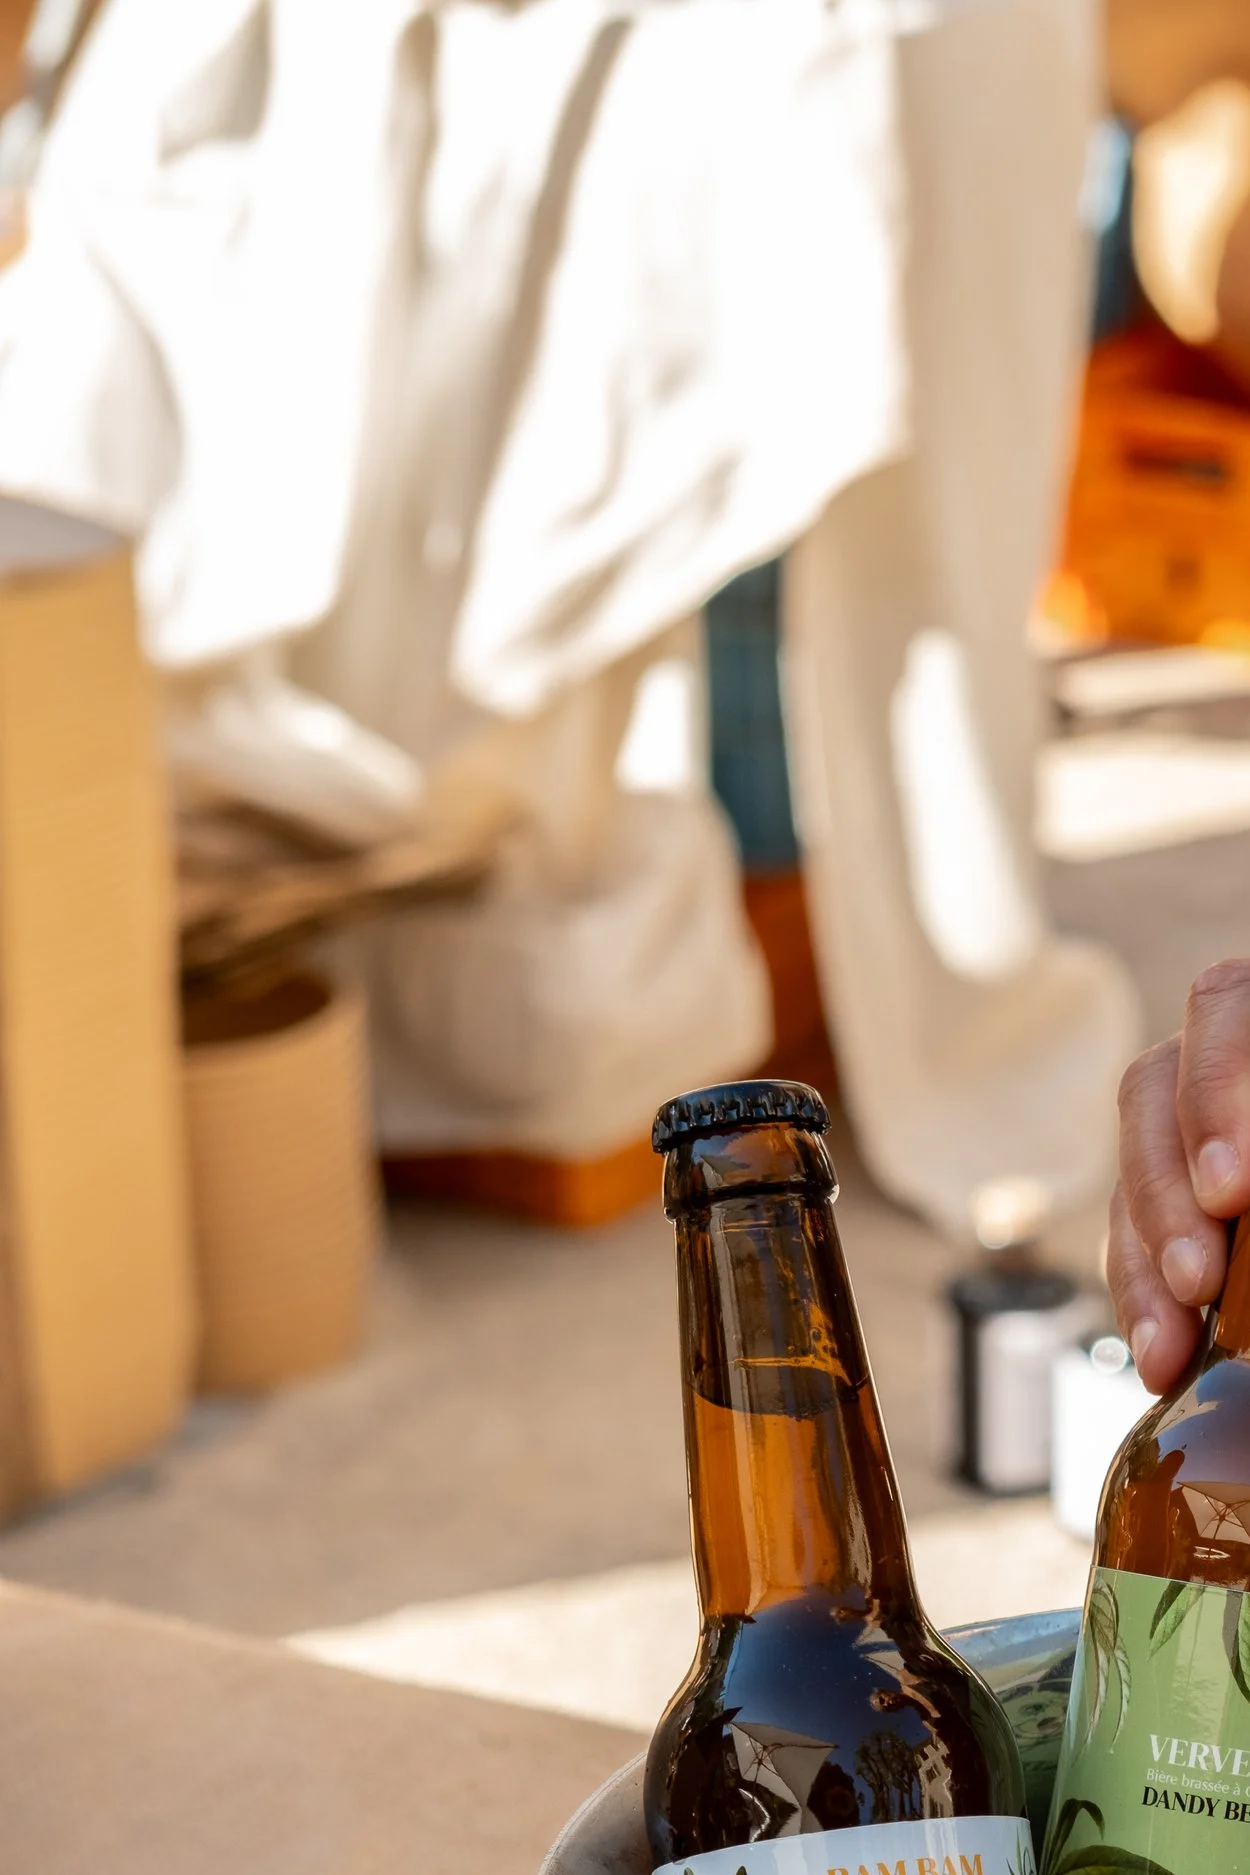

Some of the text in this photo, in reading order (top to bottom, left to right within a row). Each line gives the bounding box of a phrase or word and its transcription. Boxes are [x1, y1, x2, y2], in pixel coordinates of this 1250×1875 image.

[1146, 1768, 1178, 1785] Bière
[1181, 1773, 1230, 1794] brassée
[1233, 1784, 1241, 1796] à
[1142, 1786, 1220, 1817] DANDY
